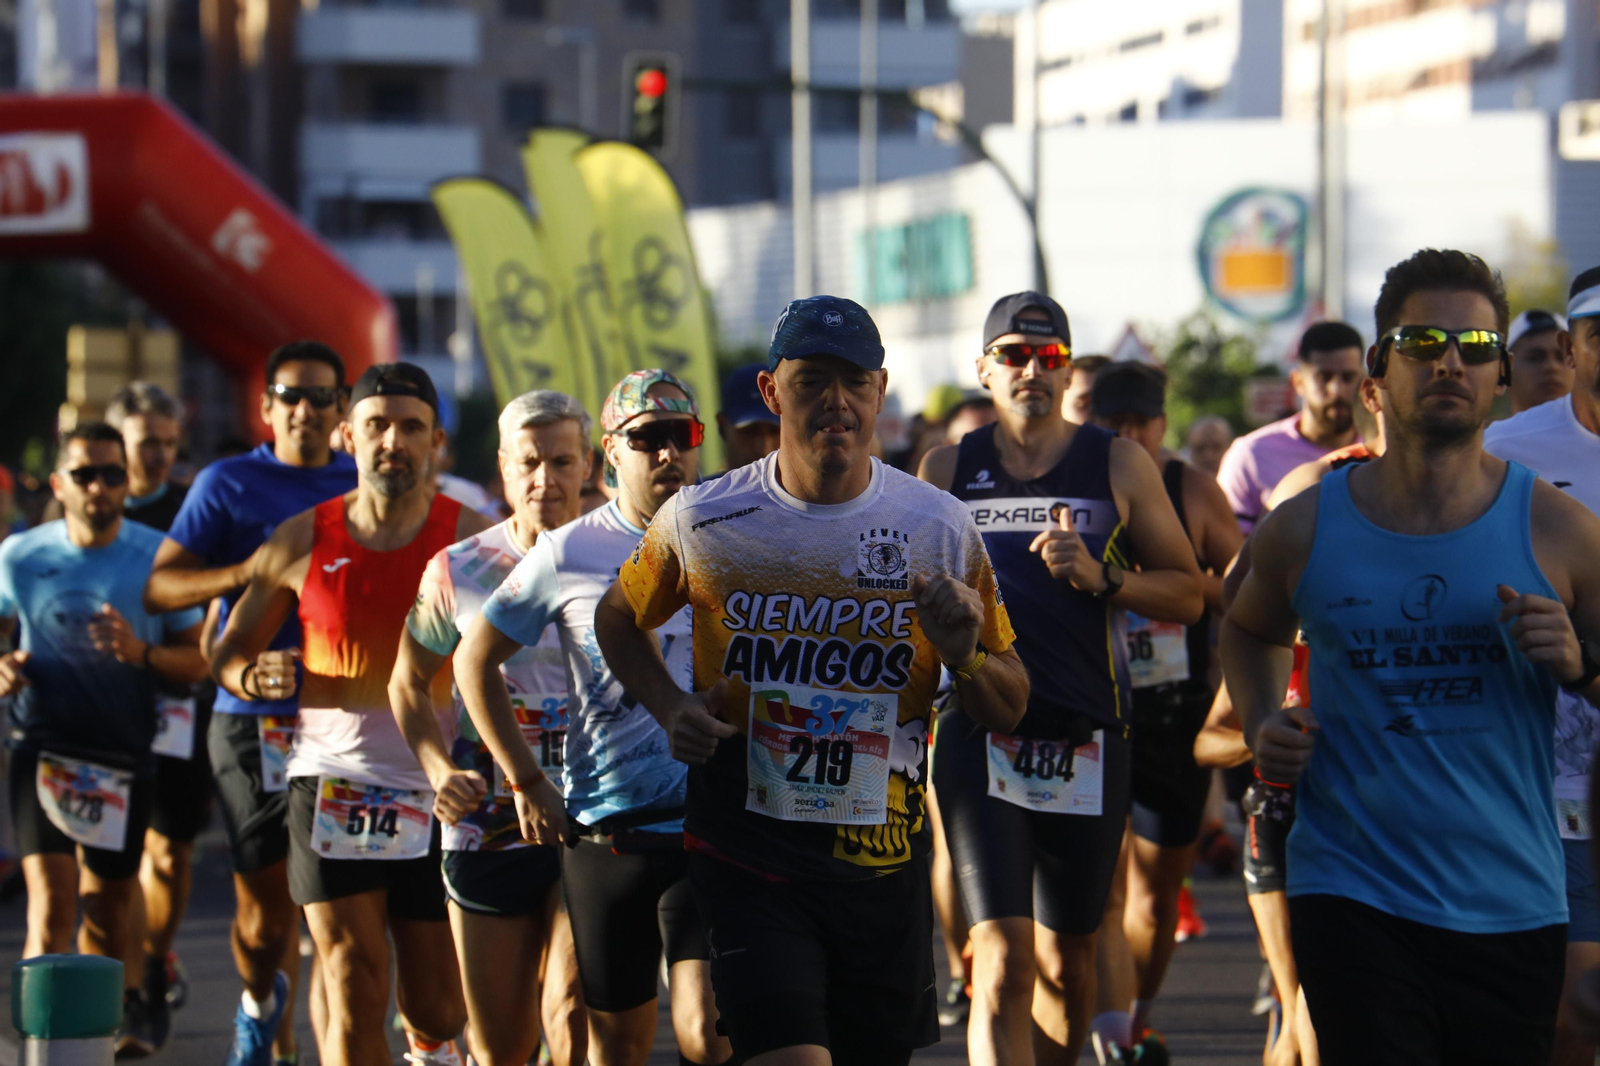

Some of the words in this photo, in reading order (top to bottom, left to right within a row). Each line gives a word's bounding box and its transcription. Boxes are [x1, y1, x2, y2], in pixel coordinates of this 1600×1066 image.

[826, 313, 842, 324] Buff
[860, 528, 909, 544] LEVEL
[857, 577, 908, 590] UNLOCKED
[722, 590, 916, 638] SIEMPRE
[1384, 627, 1418, 643] MILLA
[1423, 625, 1438, 642] DE
[1443, 624, 1491, 642] VERANO
[722, 633, 917, 690] AMIGOS
[1347, 648, 1389, 669] EL
[1393, 643, 1508, 667] SANTO
[758, 735, 790, 752] CÓRDOB
[853, 744, 867, 752] DEL
[786, 736, 853, 786] 219
[1014, 740, 1075, 782] 484
[347, 804, 399, 838] 514
